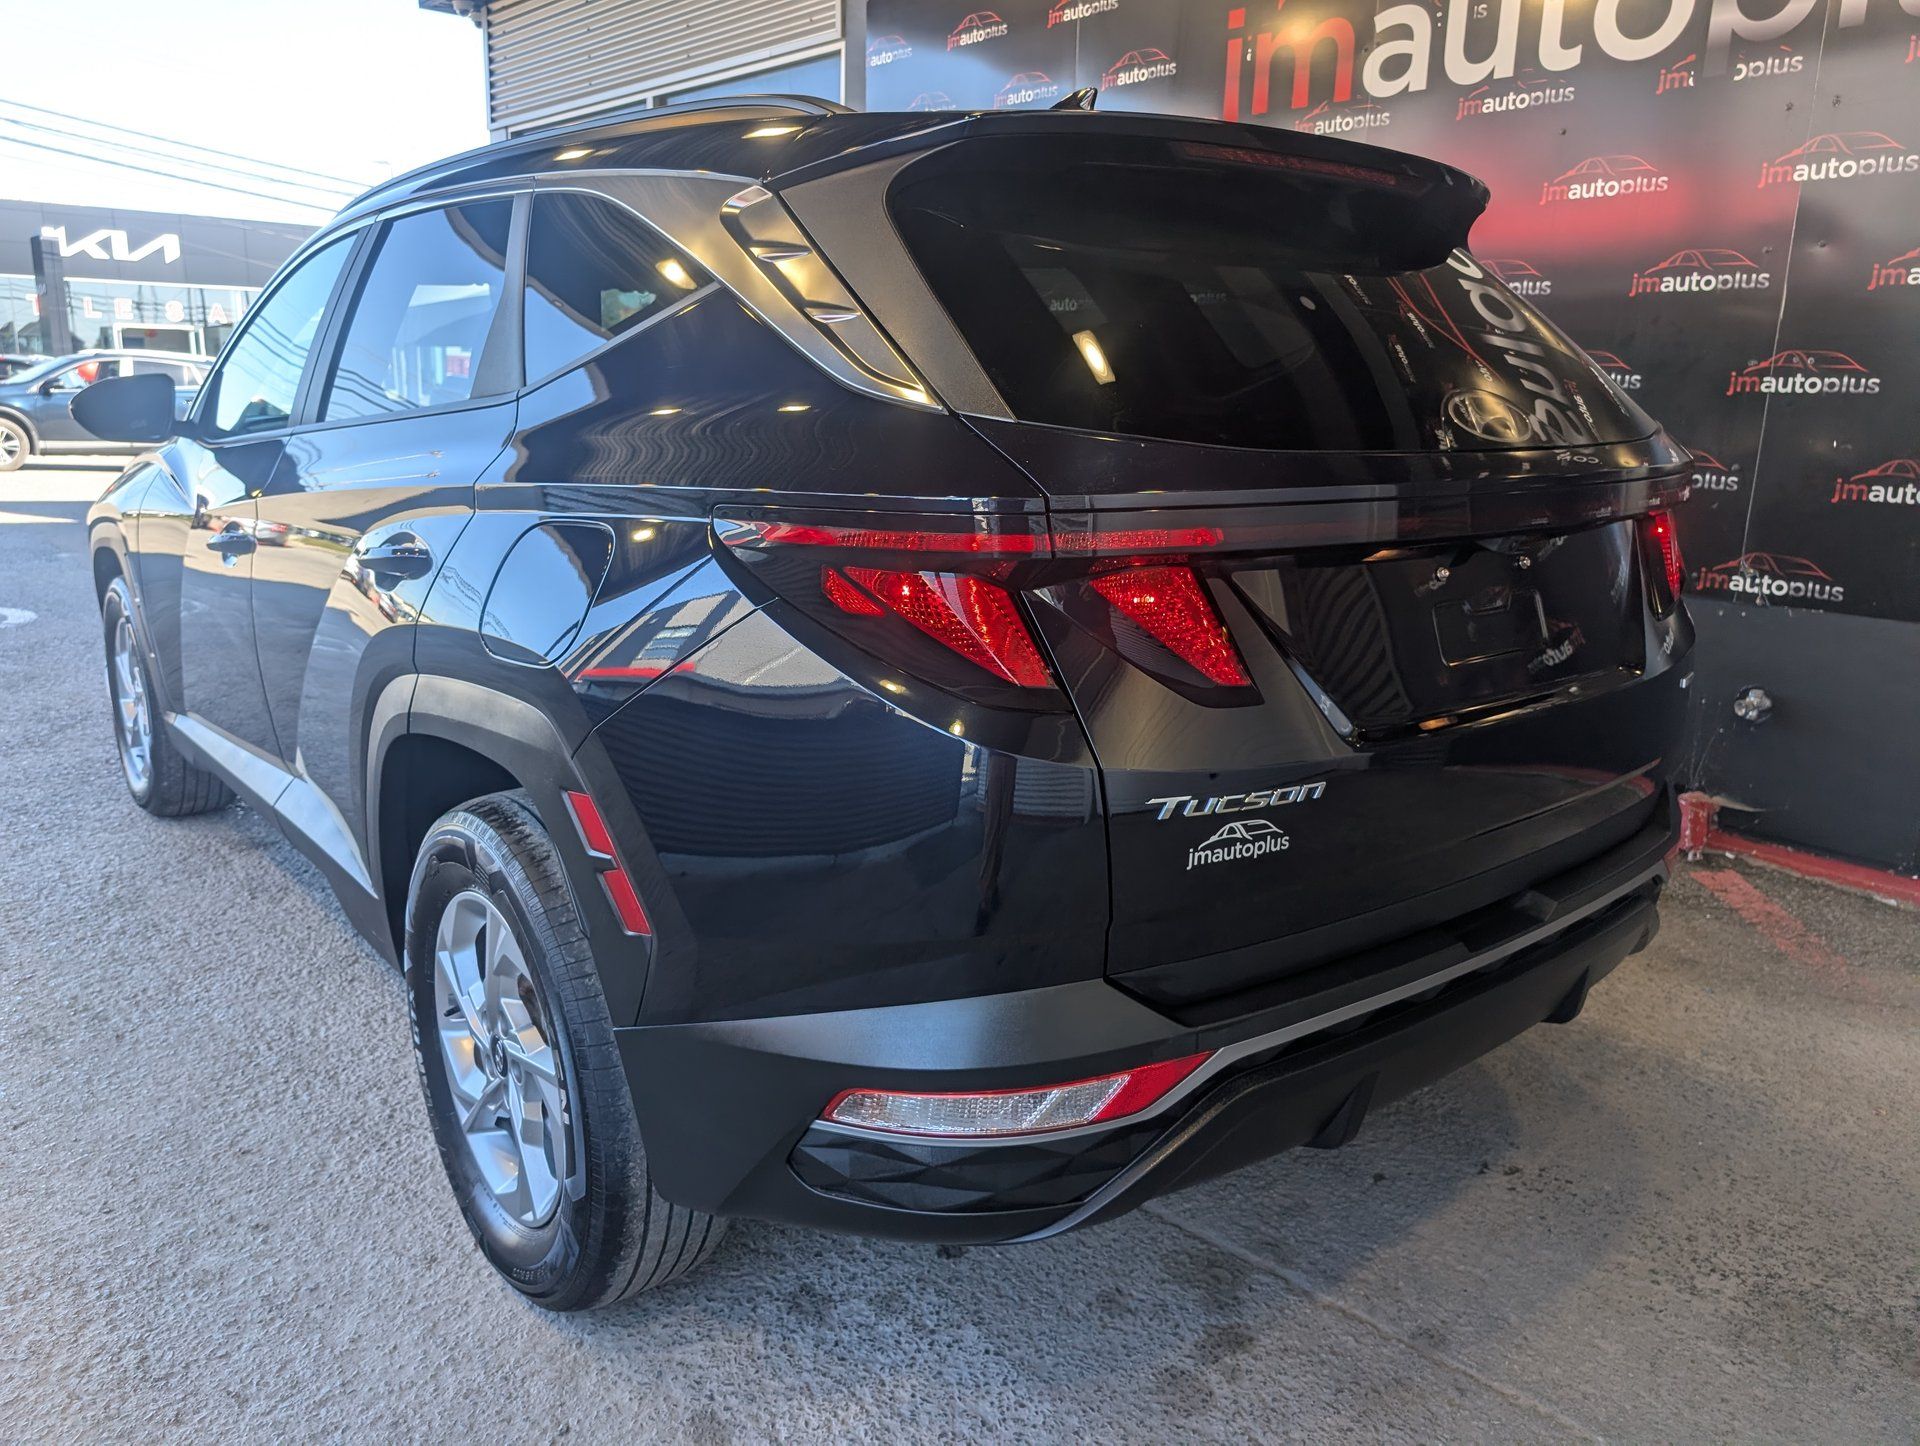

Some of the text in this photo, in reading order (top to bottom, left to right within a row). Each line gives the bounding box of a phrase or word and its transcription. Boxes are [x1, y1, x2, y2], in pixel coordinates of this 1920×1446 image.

[947, 24, 1008, 52] jmautoplus
[1101, 62, 1177, 91] jmautoplus
[1456, 84, 1575, 121] jmautoplus
[1757, 152, 1920, 190] jmautoplus
[1540, 174, 1669, 205] jmautoplus
[1629, 270, 1770, 297] jmautoplus
[1726, 370, 1880, 397] jmautoplus
[1697, 569, 1844, 601] jmautoplus
[1187, 835, 1290, 870] jmautoplus
